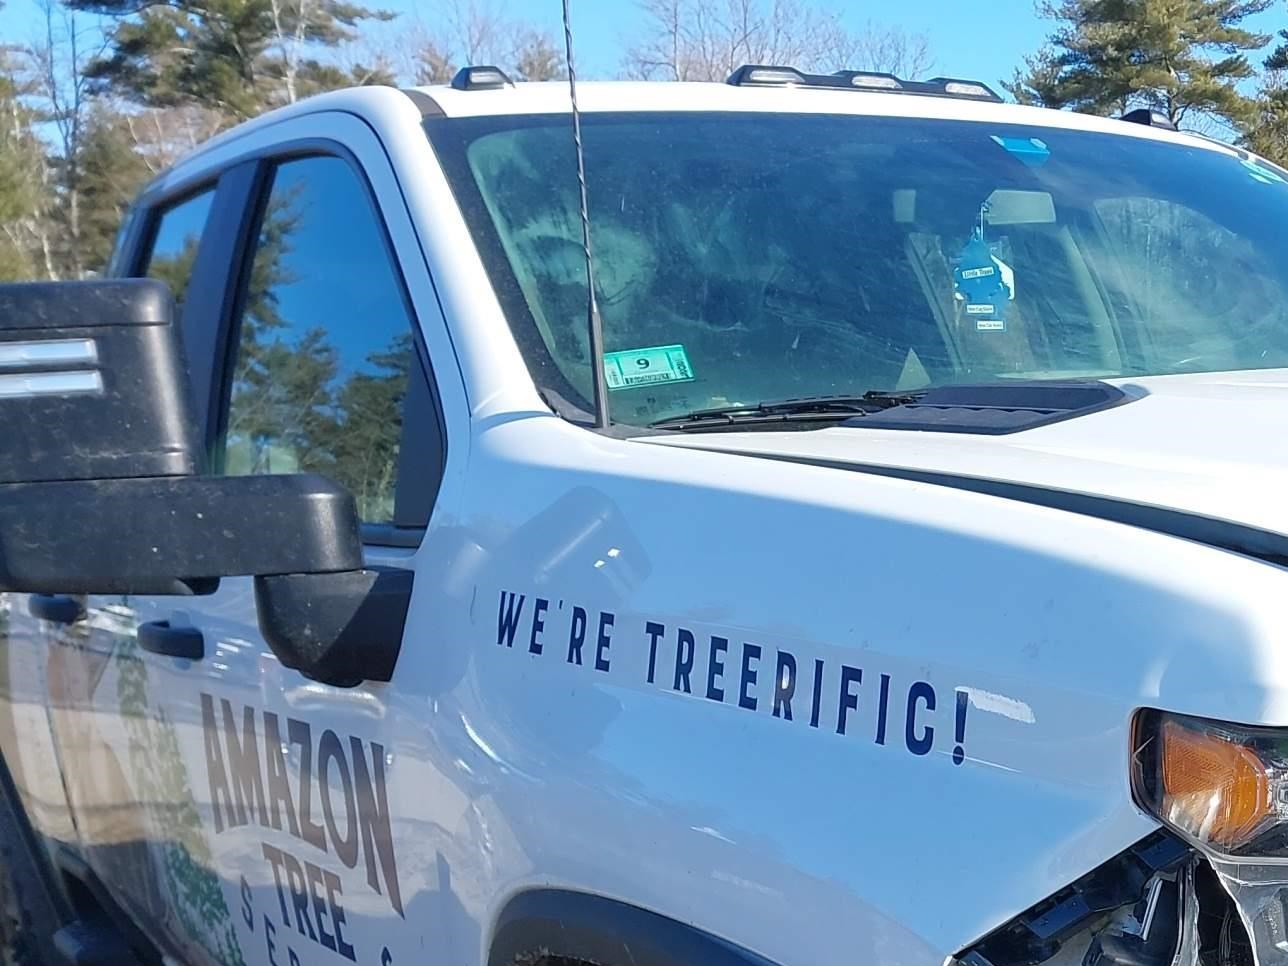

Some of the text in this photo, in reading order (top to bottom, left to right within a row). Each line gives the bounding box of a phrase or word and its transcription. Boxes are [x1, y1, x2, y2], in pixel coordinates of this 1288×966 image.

[636, 358, 650, 370] 9
[497, 590, 969, 766] WE'RE TREERIFIC!
[200, 692, 406, 921] AMAZON
[261, 842, 358, 963] TREE
